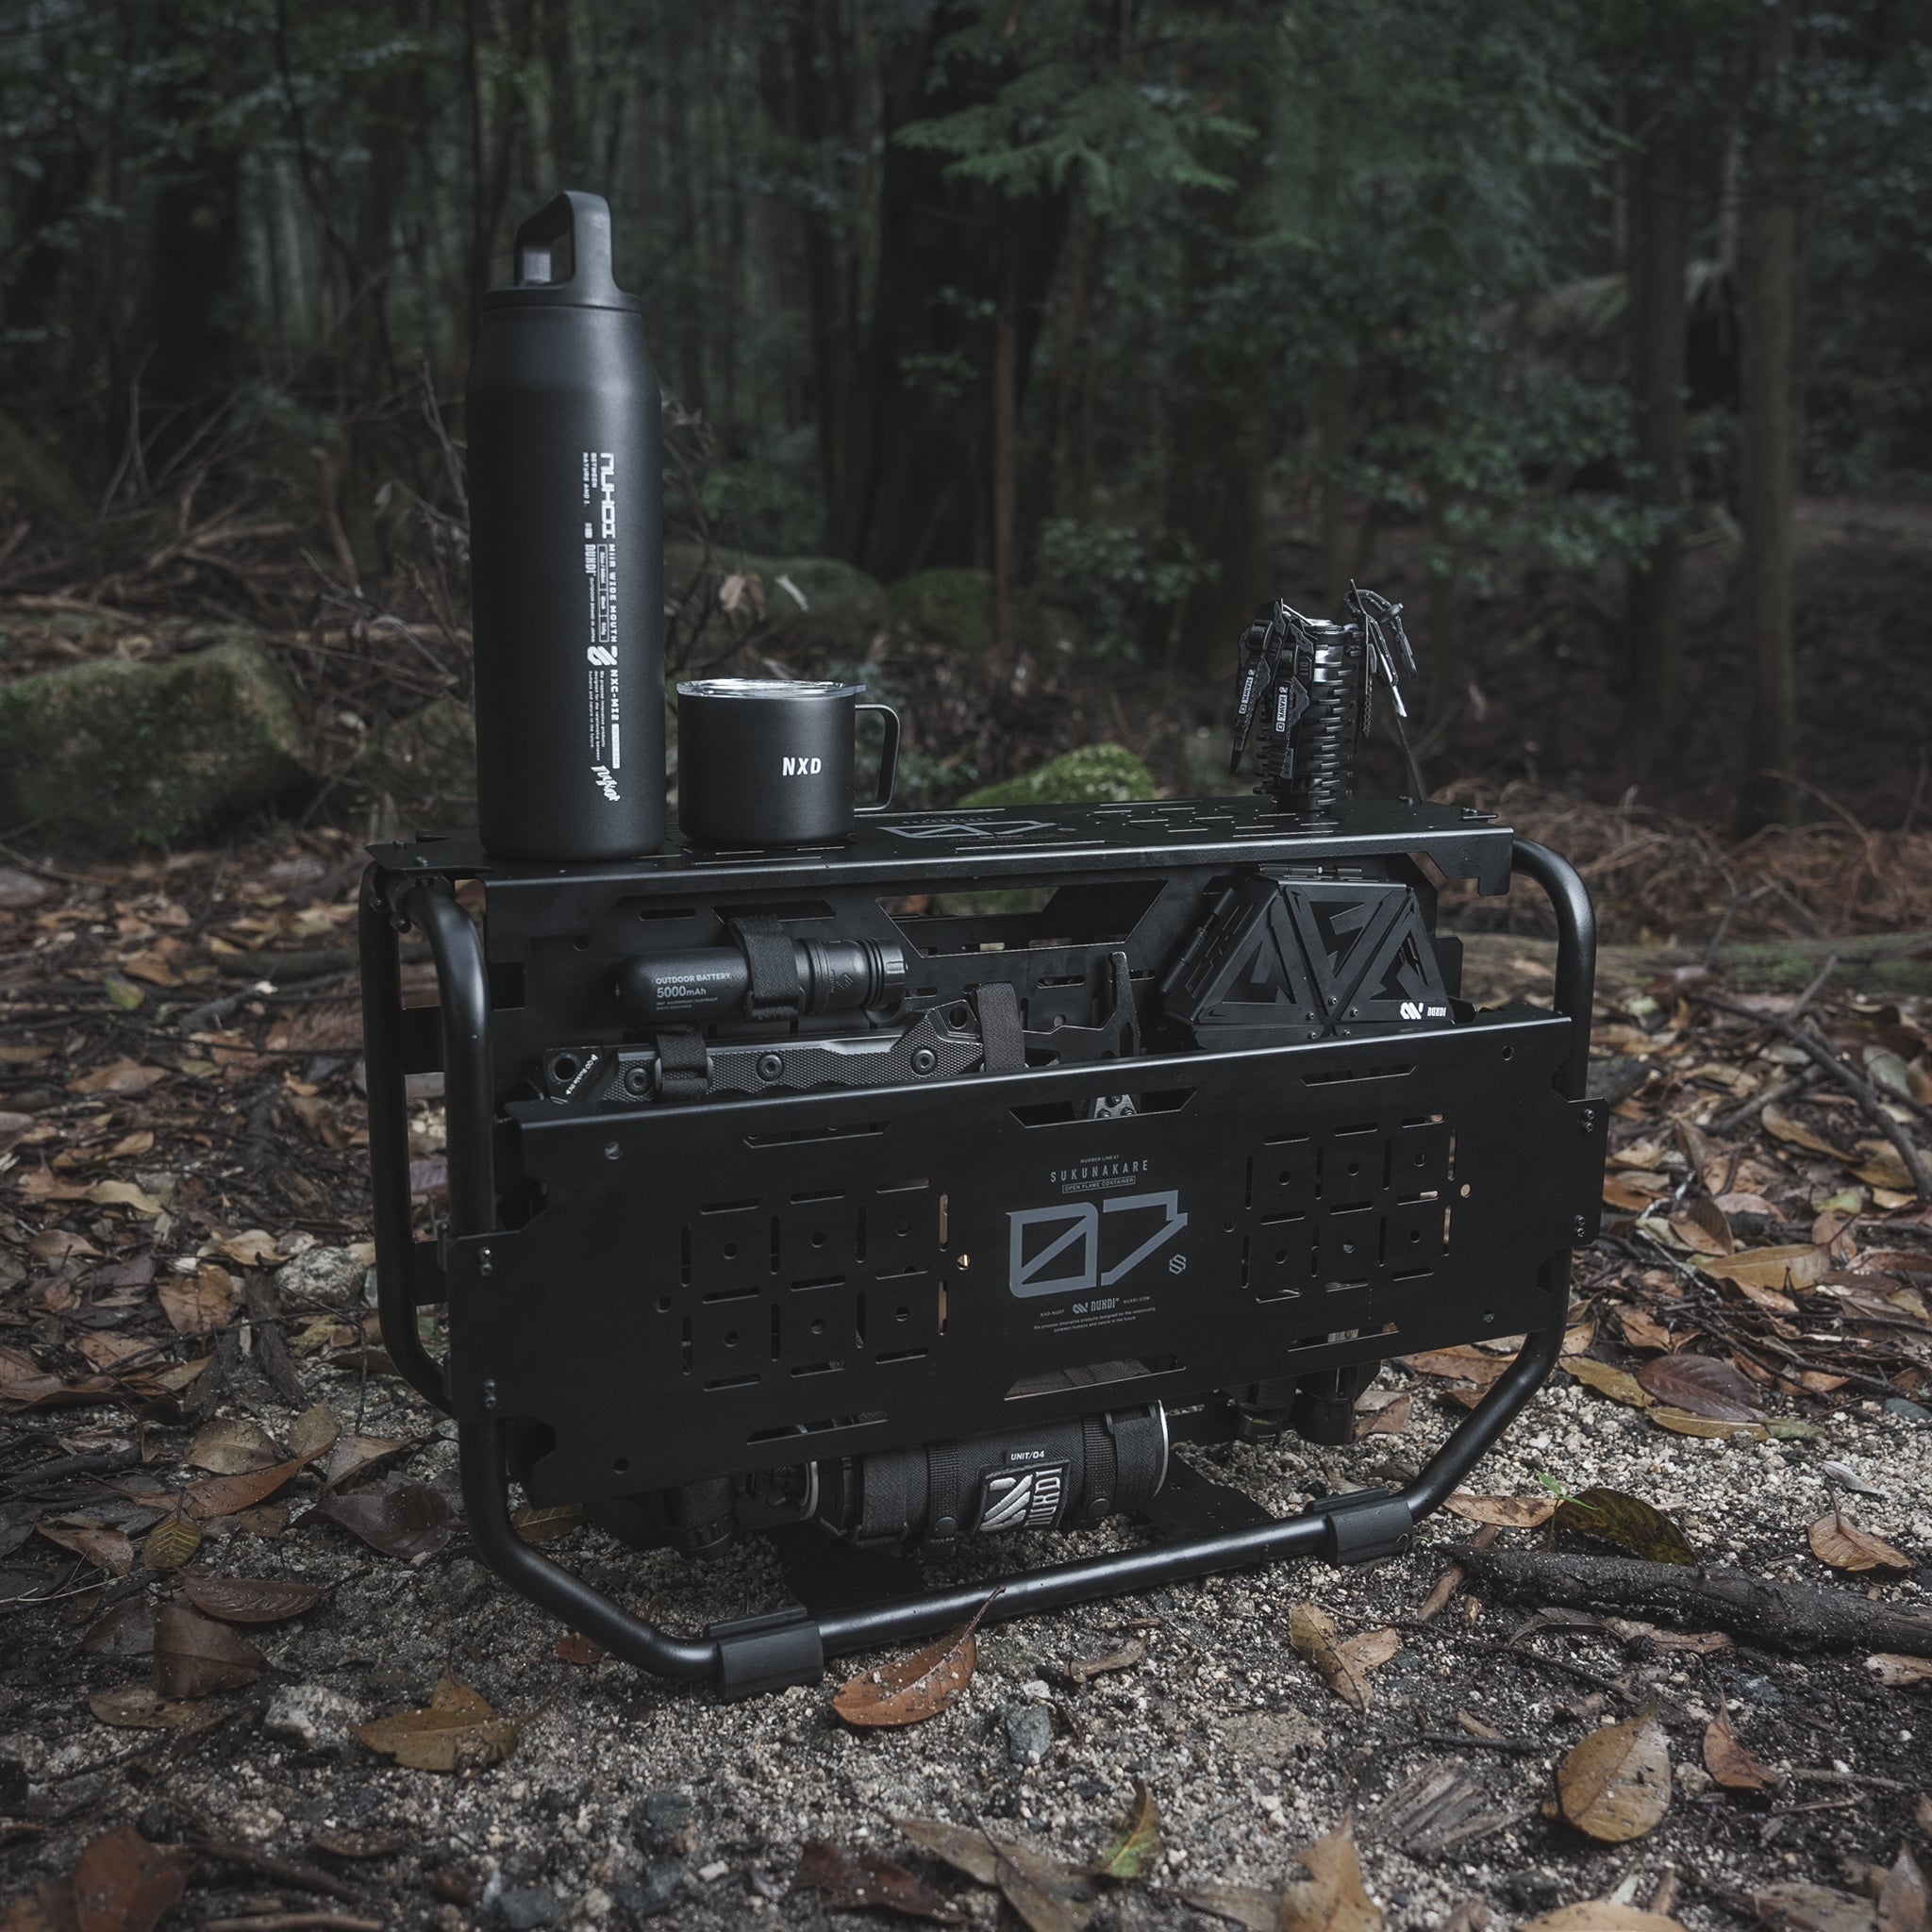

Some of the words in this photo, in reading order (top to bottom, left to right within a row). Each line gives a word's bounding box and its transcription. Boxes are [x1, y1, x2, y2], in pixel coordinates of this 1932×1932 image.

[1241, 678, 1253, 703] HAWK
[1278, 695, 1287, 720] HAWK
[783, 757, 822, 776] NXD
[656, 974, 694, 985] OUTDOOR
[696, 972, 731, 982] BATTERY
[657, 985, 707, 998] 5000mAh
[1050, 1159, 1148, 1183] SUKUNAKARE
[1101, 1176, 1134, 1187] CONTAINER
[1006, 1190, 1189, 1299] 07
[1010, 1450, 1045, 1461] UNIT/04
